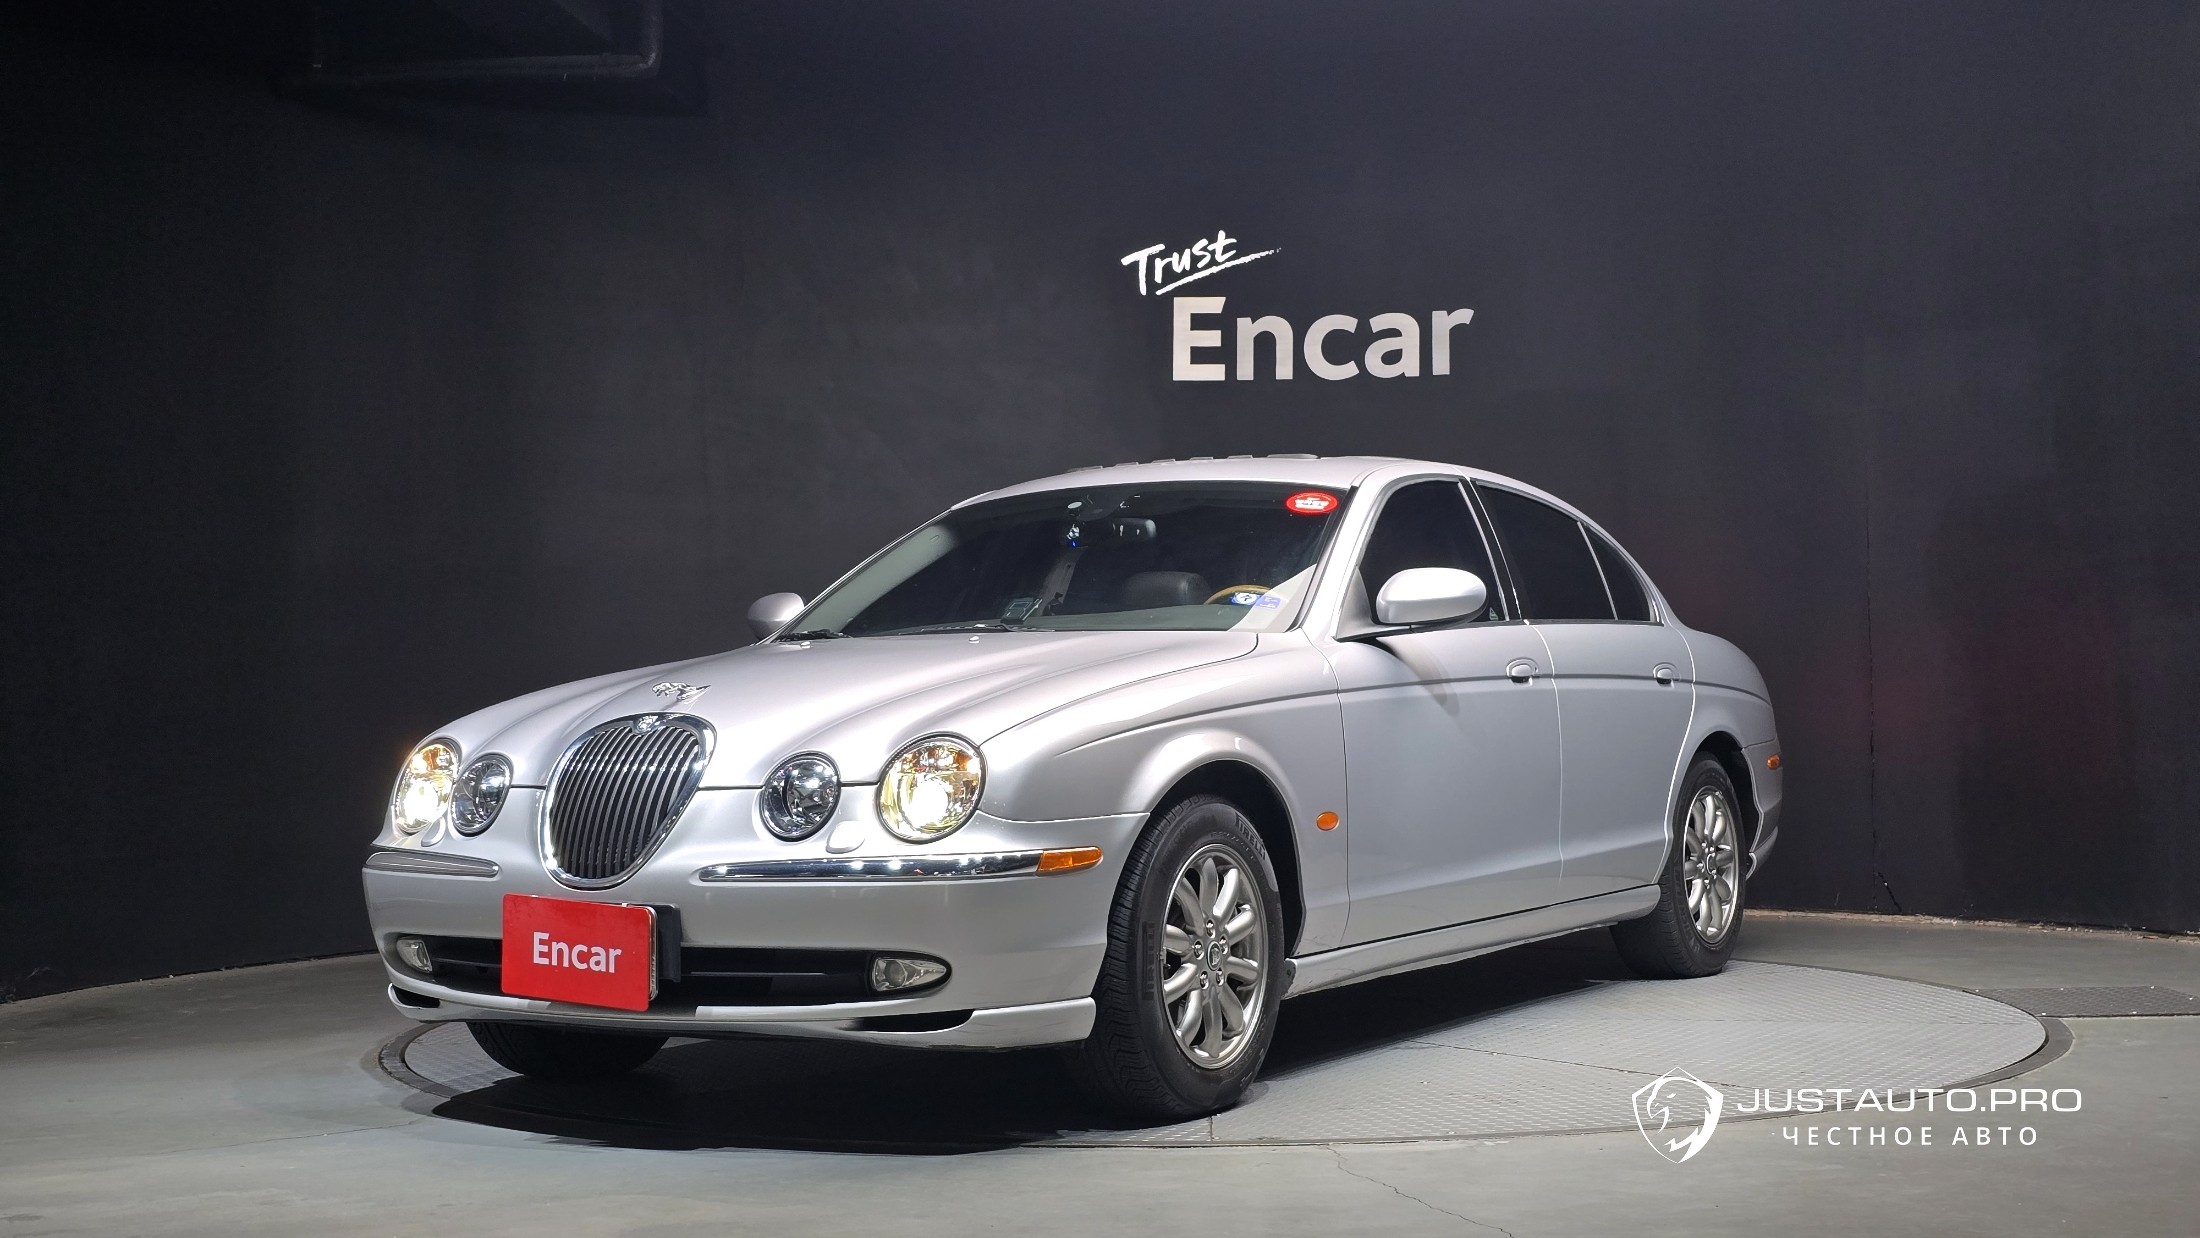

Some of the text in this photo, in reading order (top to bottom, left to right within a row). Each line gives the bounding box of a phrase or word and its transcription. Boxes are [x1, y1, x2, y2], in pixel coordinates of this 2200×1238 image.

[1121, 230, 1239, 295] Trust
[1172, 296, 1475, 381] Encar
[533, 931, 622, 974] Encar
